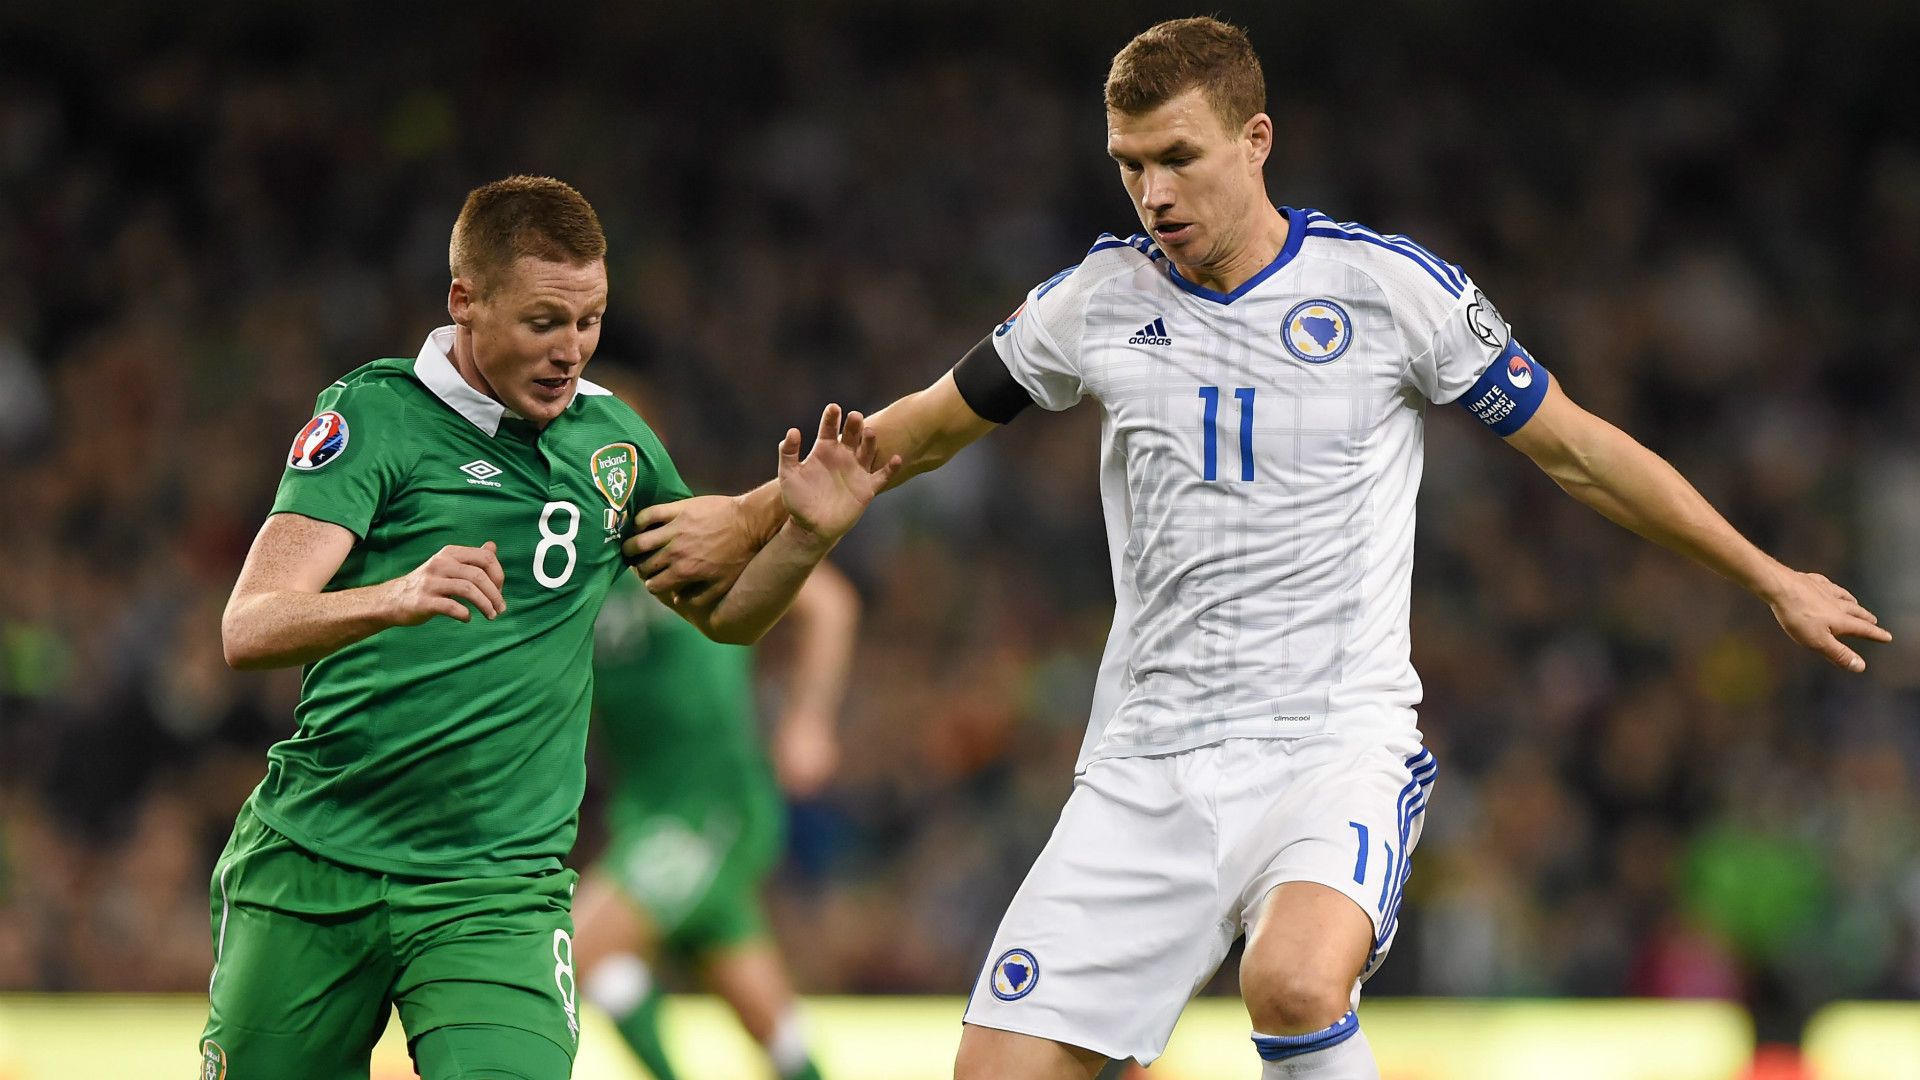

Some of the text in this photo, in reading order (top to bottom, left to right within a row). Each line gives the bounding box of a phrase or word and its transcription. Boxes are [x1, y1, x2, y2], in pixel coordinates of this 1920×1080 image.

[1128, 334, 1172, 346] adidas
[1468, 385, 1502, 412] UNITE
[1478, 393, 1509, 419] AGAINST
[1199, 386, 1255, 481] 11
[598, 451, 627, 469] Ireland
[533, 500, 581, 589] 8
[1273, 714, 1311, 722] climacool
[1349, 821, 1393, 913] 11
[553, 928, 576, 1014] 8
